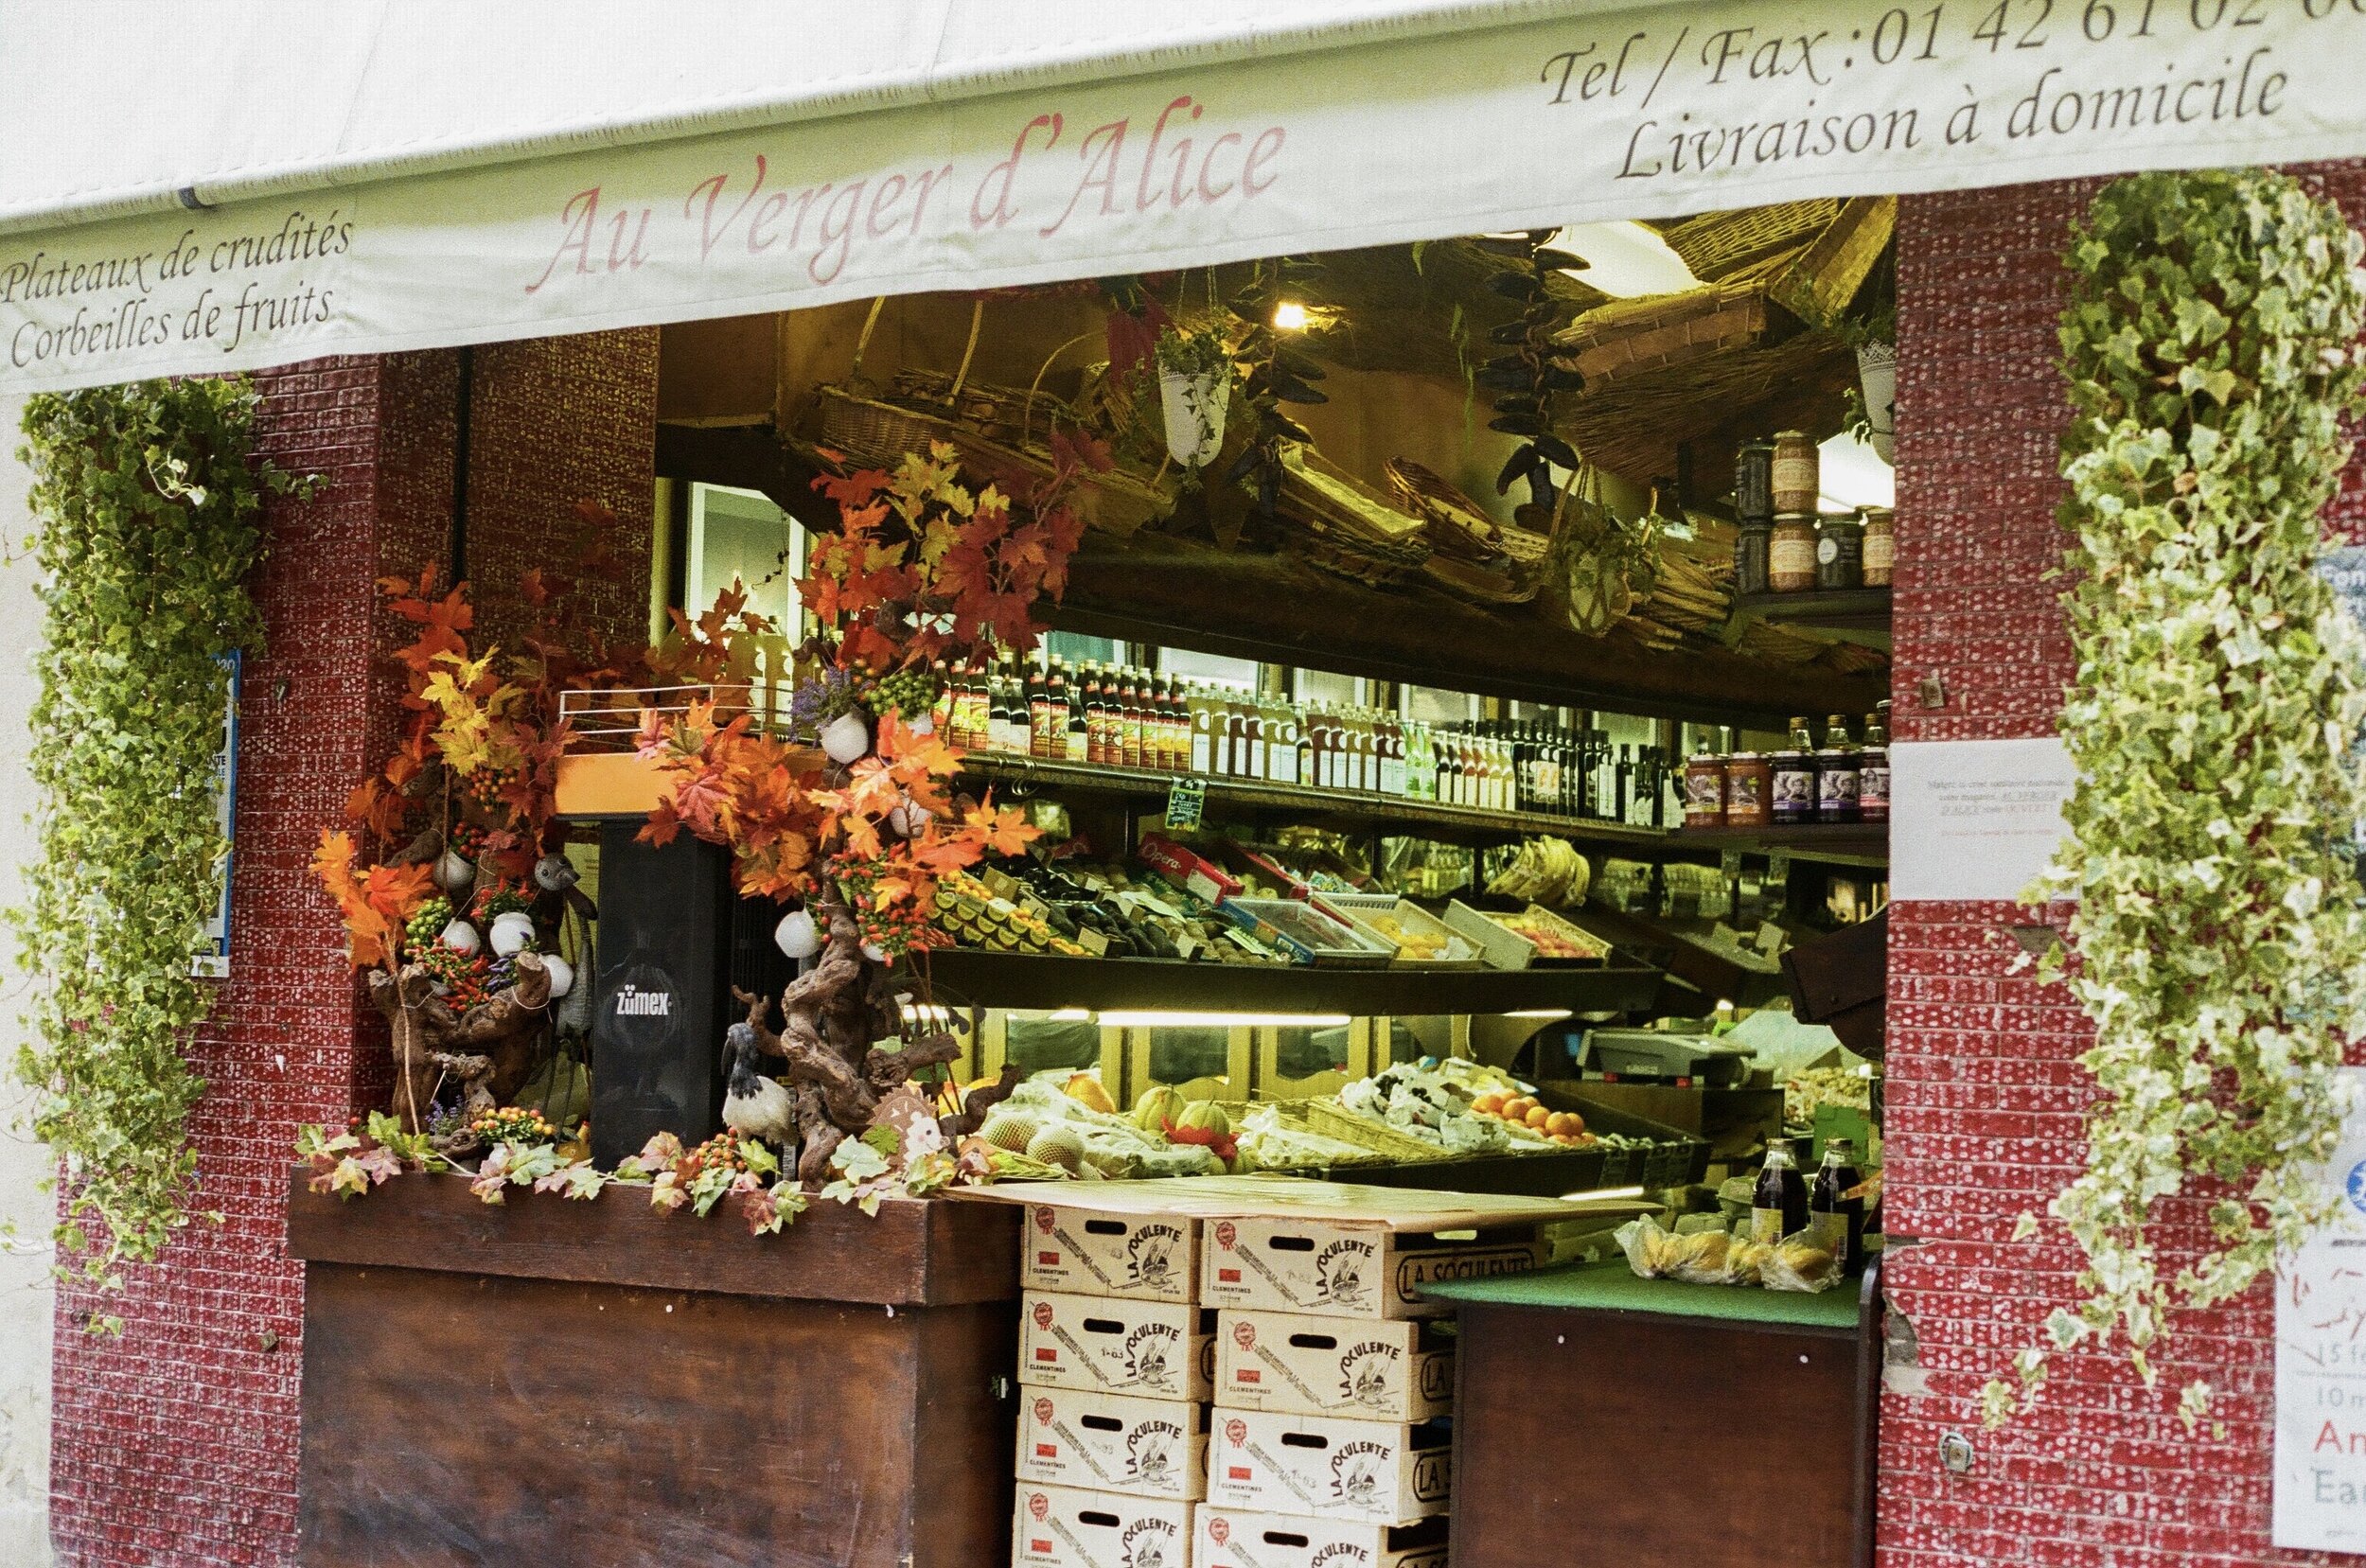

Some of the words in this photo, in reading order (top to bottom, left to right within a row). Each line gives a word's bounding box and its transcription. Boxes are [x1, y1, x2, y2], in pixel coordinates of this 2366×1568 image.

[1542, 31, 1646, 105] Tel
[1973, 0, 2049, 52] 42
[2082, 0, 2157, 42] 61
[1614, 99, 1921, 180] Livraison
[1946, 84, 1982, 145] à
[2007, 46, 2288, 139] domicile
[524, 187, 650, 293] Au
[684, 155, 953, 286] Verger
[970, 96, 1287, 237] d'Alice
[0, 253, 152, 303] Plateaux
[159, 229, 198, 281] de
[210, 210, 353, 273] crudités
[11, 299, 172, 368] Corbeilles
[182, 289, 221, 341] de
[223, 280, 333, 353] fruits
[1419, 1462, 1439, 1492] LA
